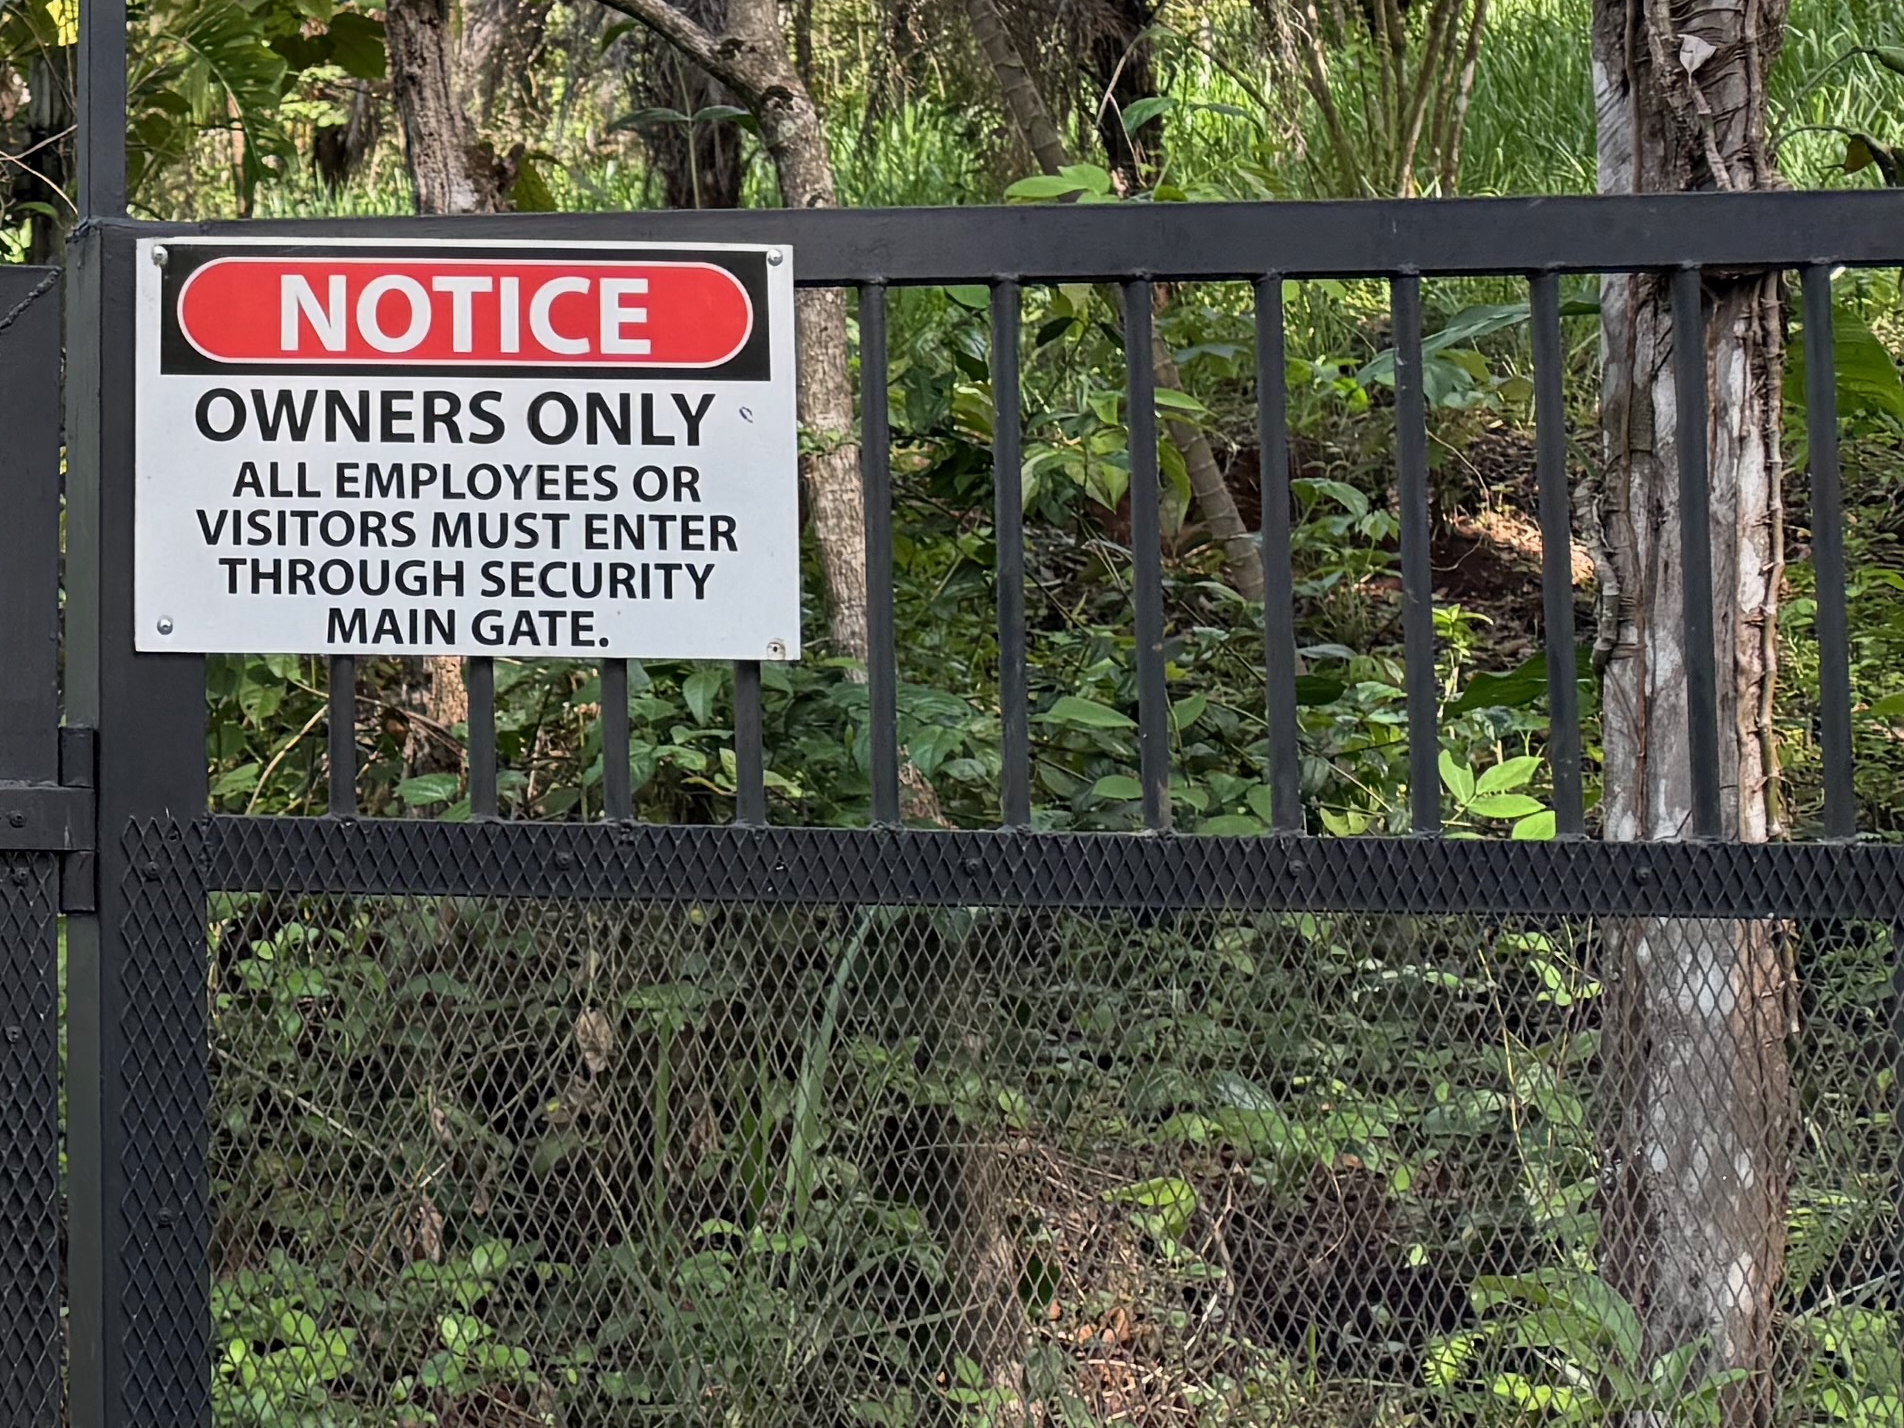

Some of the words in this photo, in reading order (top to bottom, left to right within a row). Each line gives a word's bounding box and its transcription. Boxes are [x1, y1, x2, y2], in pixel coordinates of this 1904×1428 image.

[281, 274, 651, 355] NOTICE
[196, 388, 504, 444] OWNERS
[528, 392, 715, 446] ONLY
[233, 462, 320, 497] ALL
[337, 463, 617, 501] EMPLOYEES
[633, 466, 700, 502] OR
[197, 510, 415, 547] VISITORS
[432, 512, 569, 549] MUST
[586, 514, 737, 551] ENTER
[219, 558, 463, 596] THROUGH
[481, 561, 714, 599] SECURITY
[328, 608, 455, 644] MAIN
[472, 610, 608, 647] GATE.
